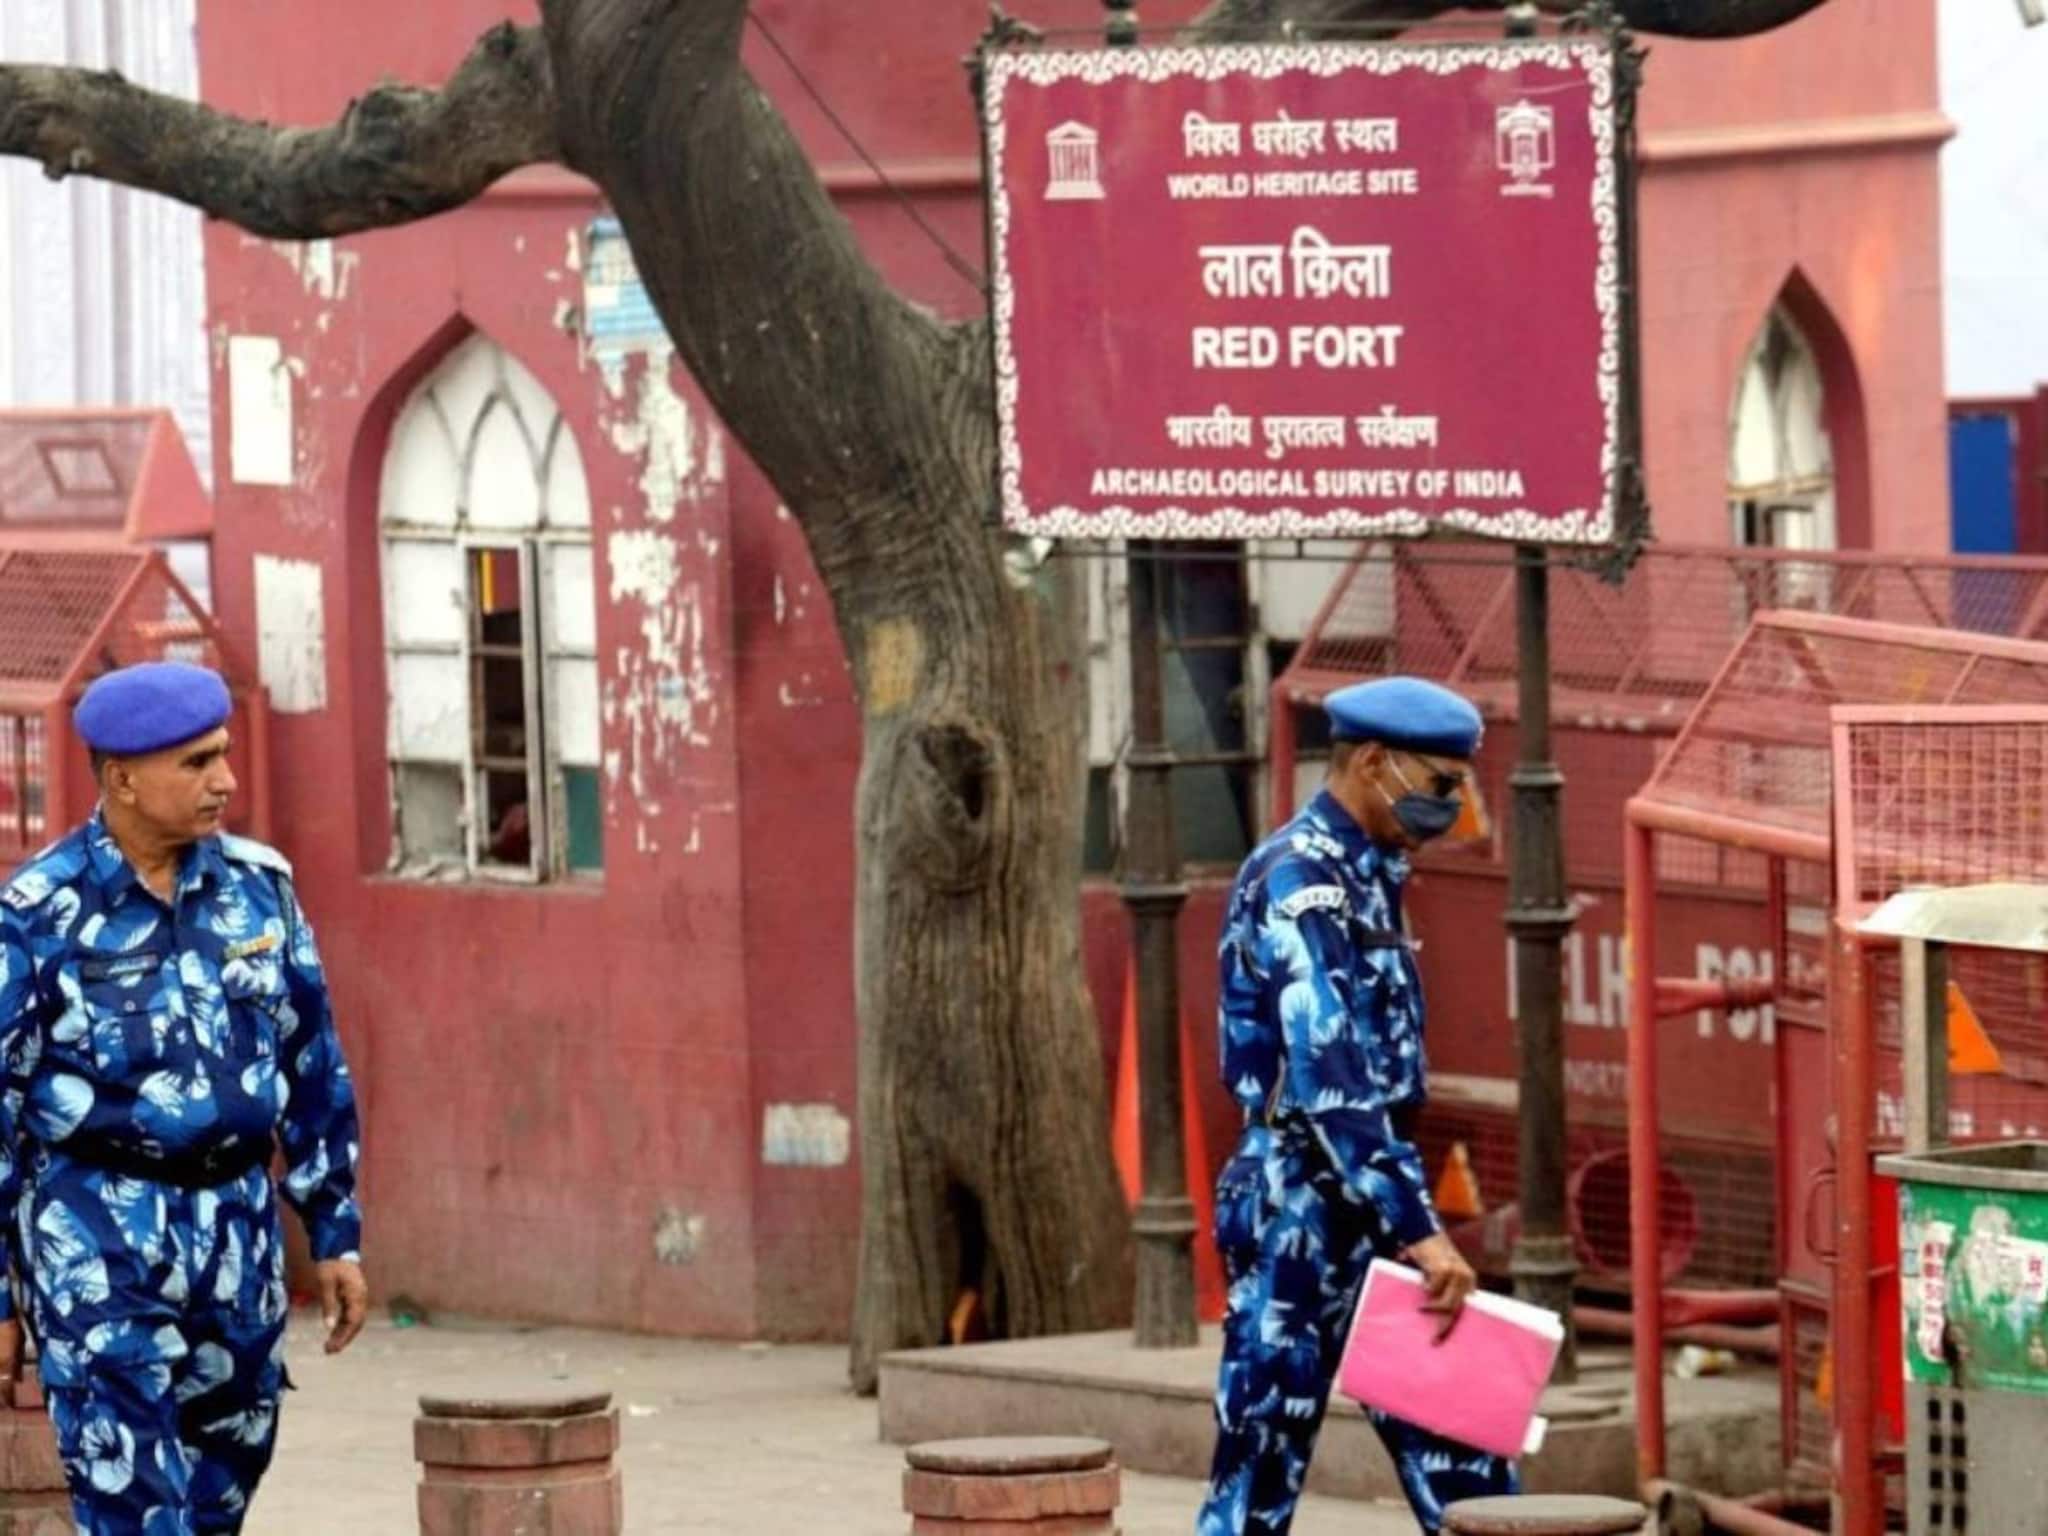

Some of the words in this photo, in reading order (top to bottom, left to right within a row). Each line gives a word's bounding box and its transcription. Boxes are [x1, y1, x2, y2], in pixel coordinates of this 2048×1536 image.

[1182, 111, 1241, 156] विश्व
[1251, 109, 1326, 158] धरोहर
[1332, 118, 1398, 152] स्थल
[1168, 173, 1250, 198] WORLD
[1253, 170, 1362, 197] HERITAGE
[1367, 169, 1418, 195] SITE
[1198, 245, 1284, 297] लाल
[1192, 326, 1279, 368] RED
[1289, 325, 1403, 368] FORT
[1166, 404, 1253, 447] भारतीय
[1262, 416, 1346, 459] पुरातत्व
[1091, 469, 1309, 497] ARCHAEOLOGICAL
[1314, 470, 1410, 497] SURVEY
[1416, 470, 1448, 497] OF
[1454, 470, 1524, 497] INDIA
